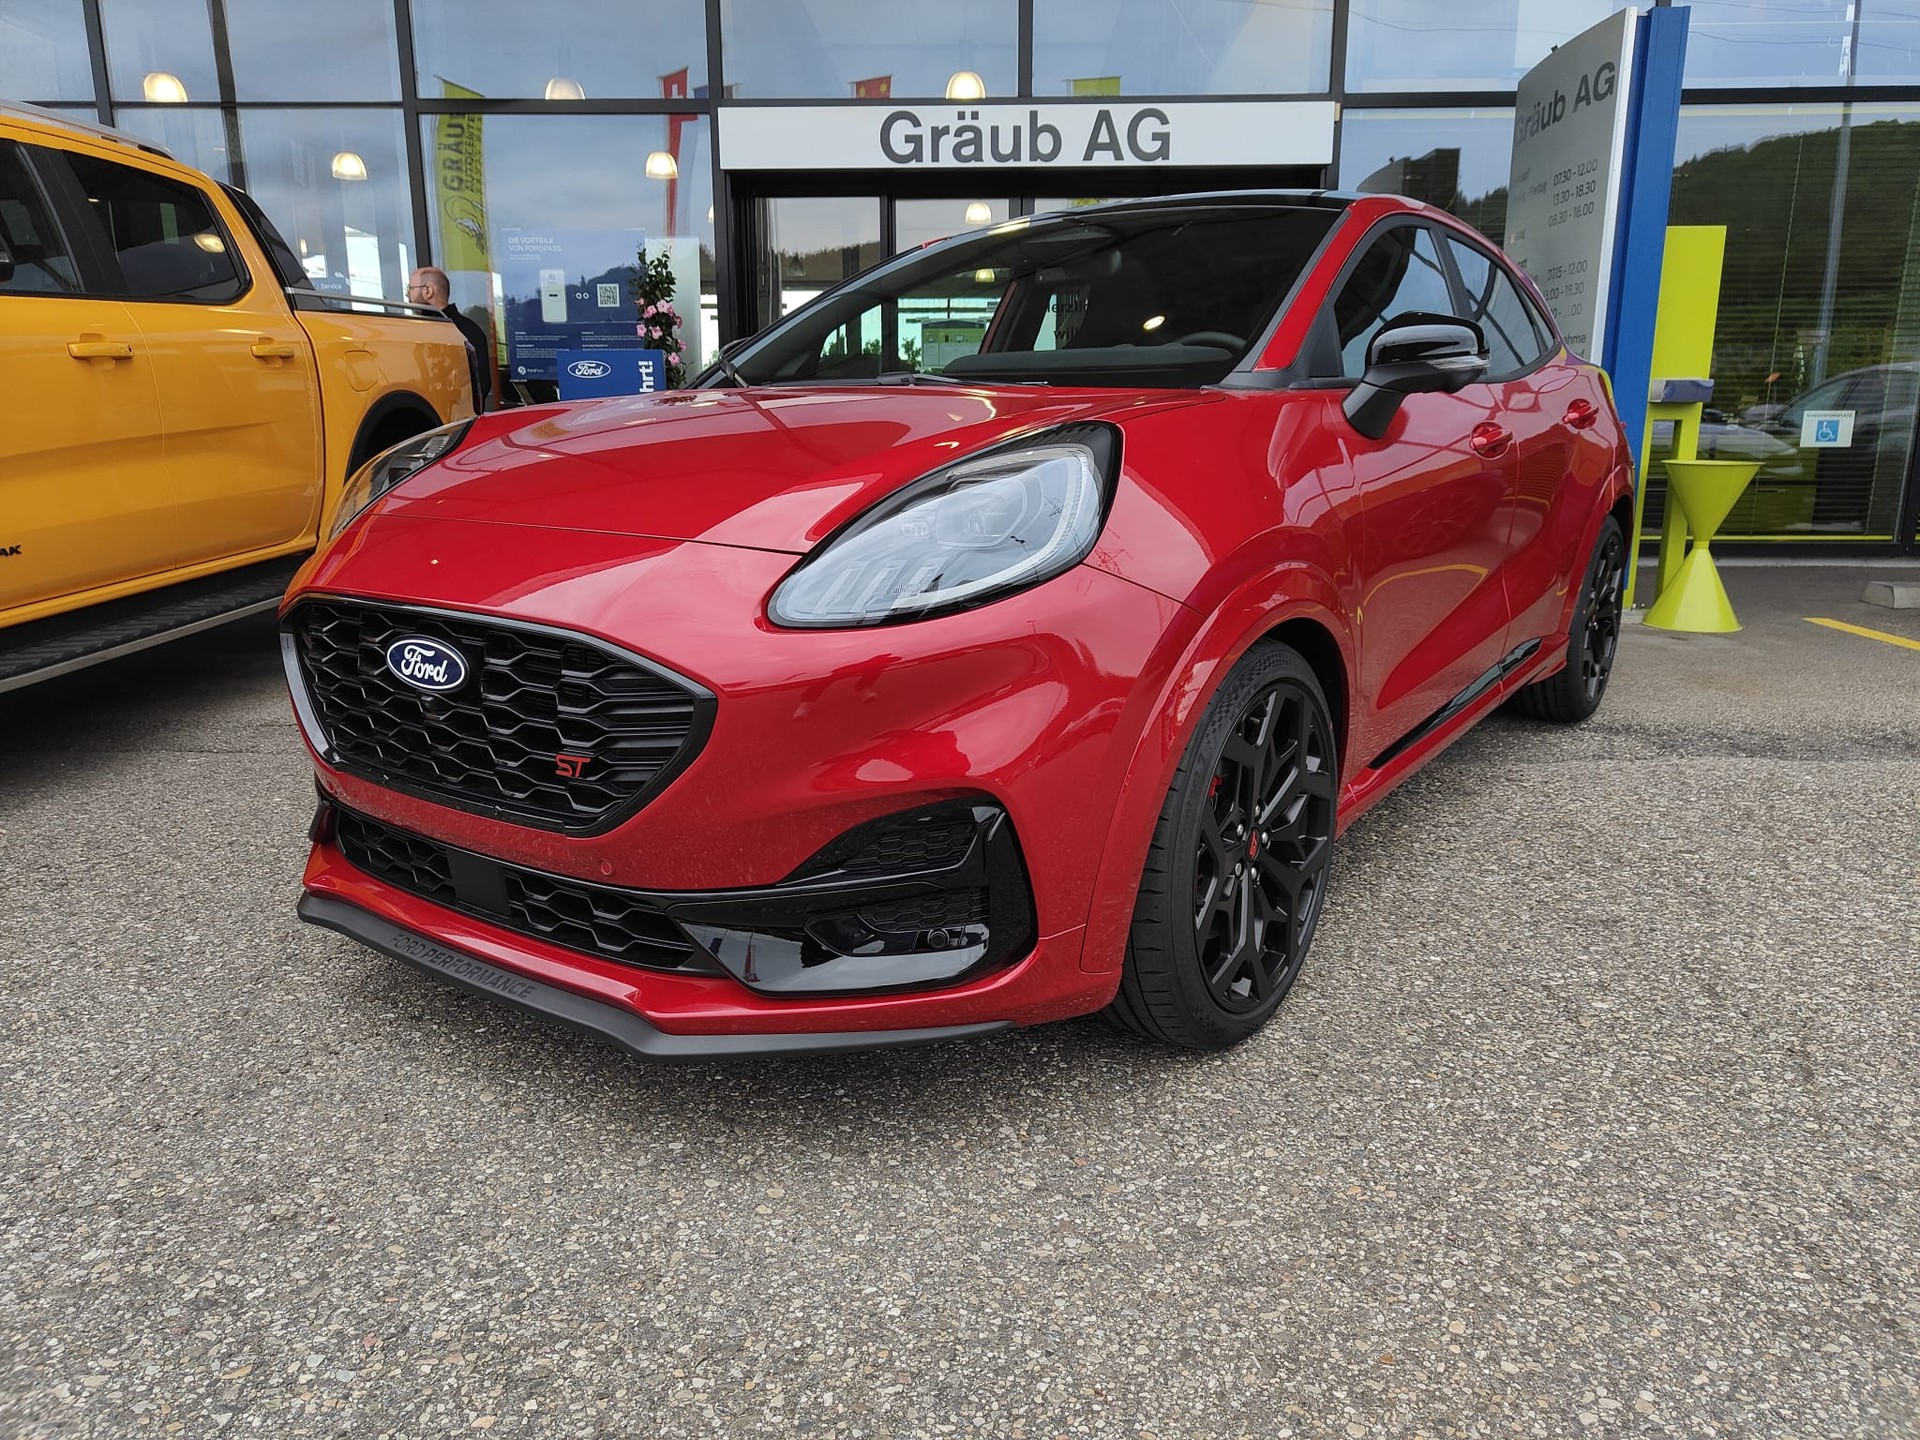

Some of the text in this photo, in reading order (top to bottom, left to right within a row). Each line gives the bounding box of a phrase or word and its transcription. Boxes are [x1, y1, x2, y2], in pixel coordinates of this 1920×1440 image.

[1514, 62, 1616, 147] Gräub AG
[880, 108, 1171, 164] Gräub AG
[575, 362, 604, 376] Ford
[401, 644, 448, 684] Ford
[555, 754, 591, 778] ST
[388, 933, 538, 999] FORD PERFORMANCE
